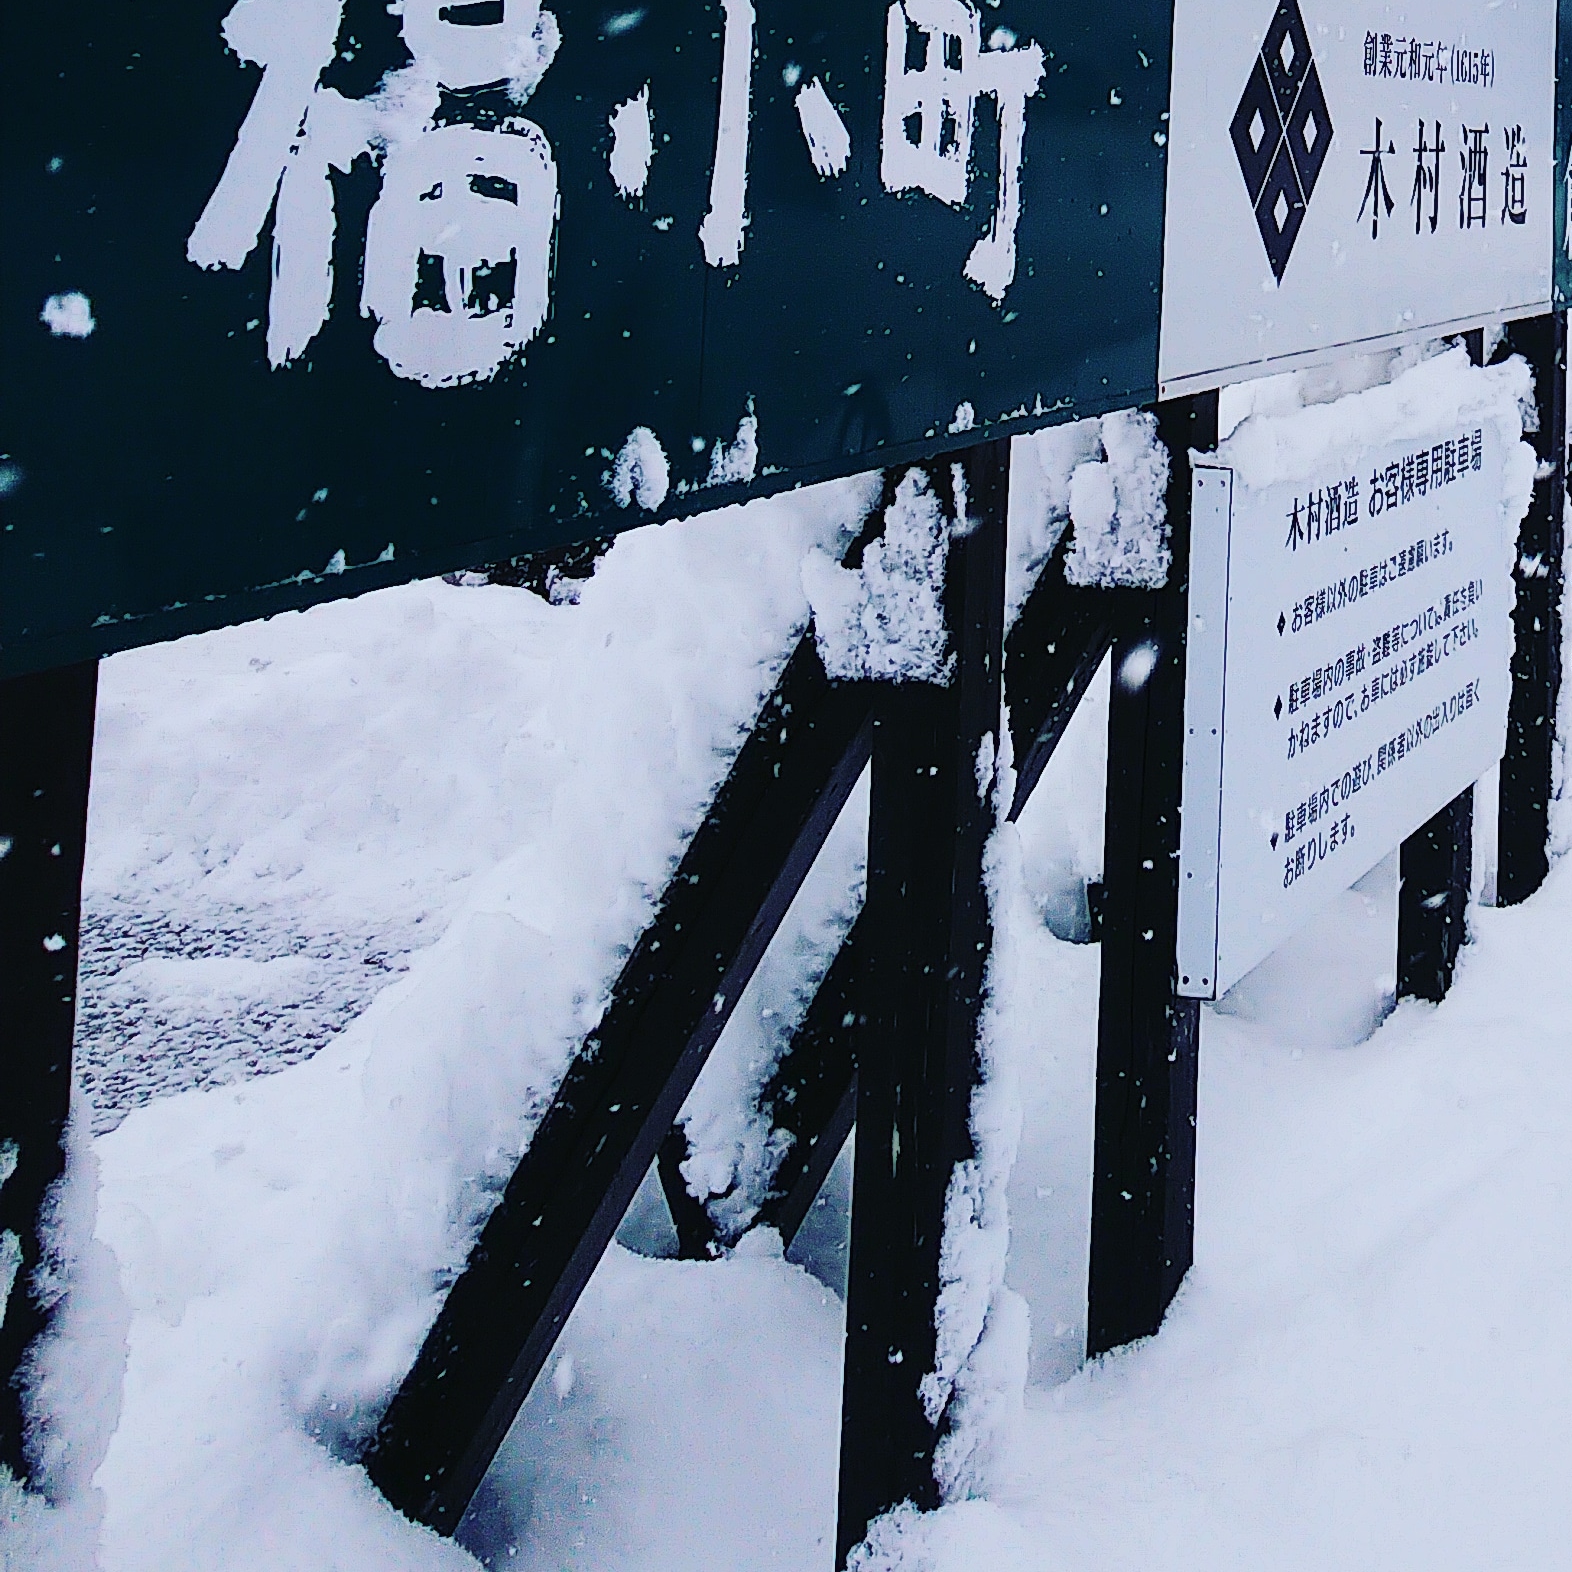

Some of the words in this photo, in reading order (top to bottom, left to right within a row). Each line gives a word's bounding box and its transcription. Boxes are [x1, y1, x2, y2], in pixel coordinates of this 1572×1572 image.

[1356, 117, 1528, 240] 木村酒造
[1285, 476, 1359, 551] 木村酒造
[1369, 429, 1482, 517] お客様専用駐車場
[1283, 813, 1355, 888] お断りします。
